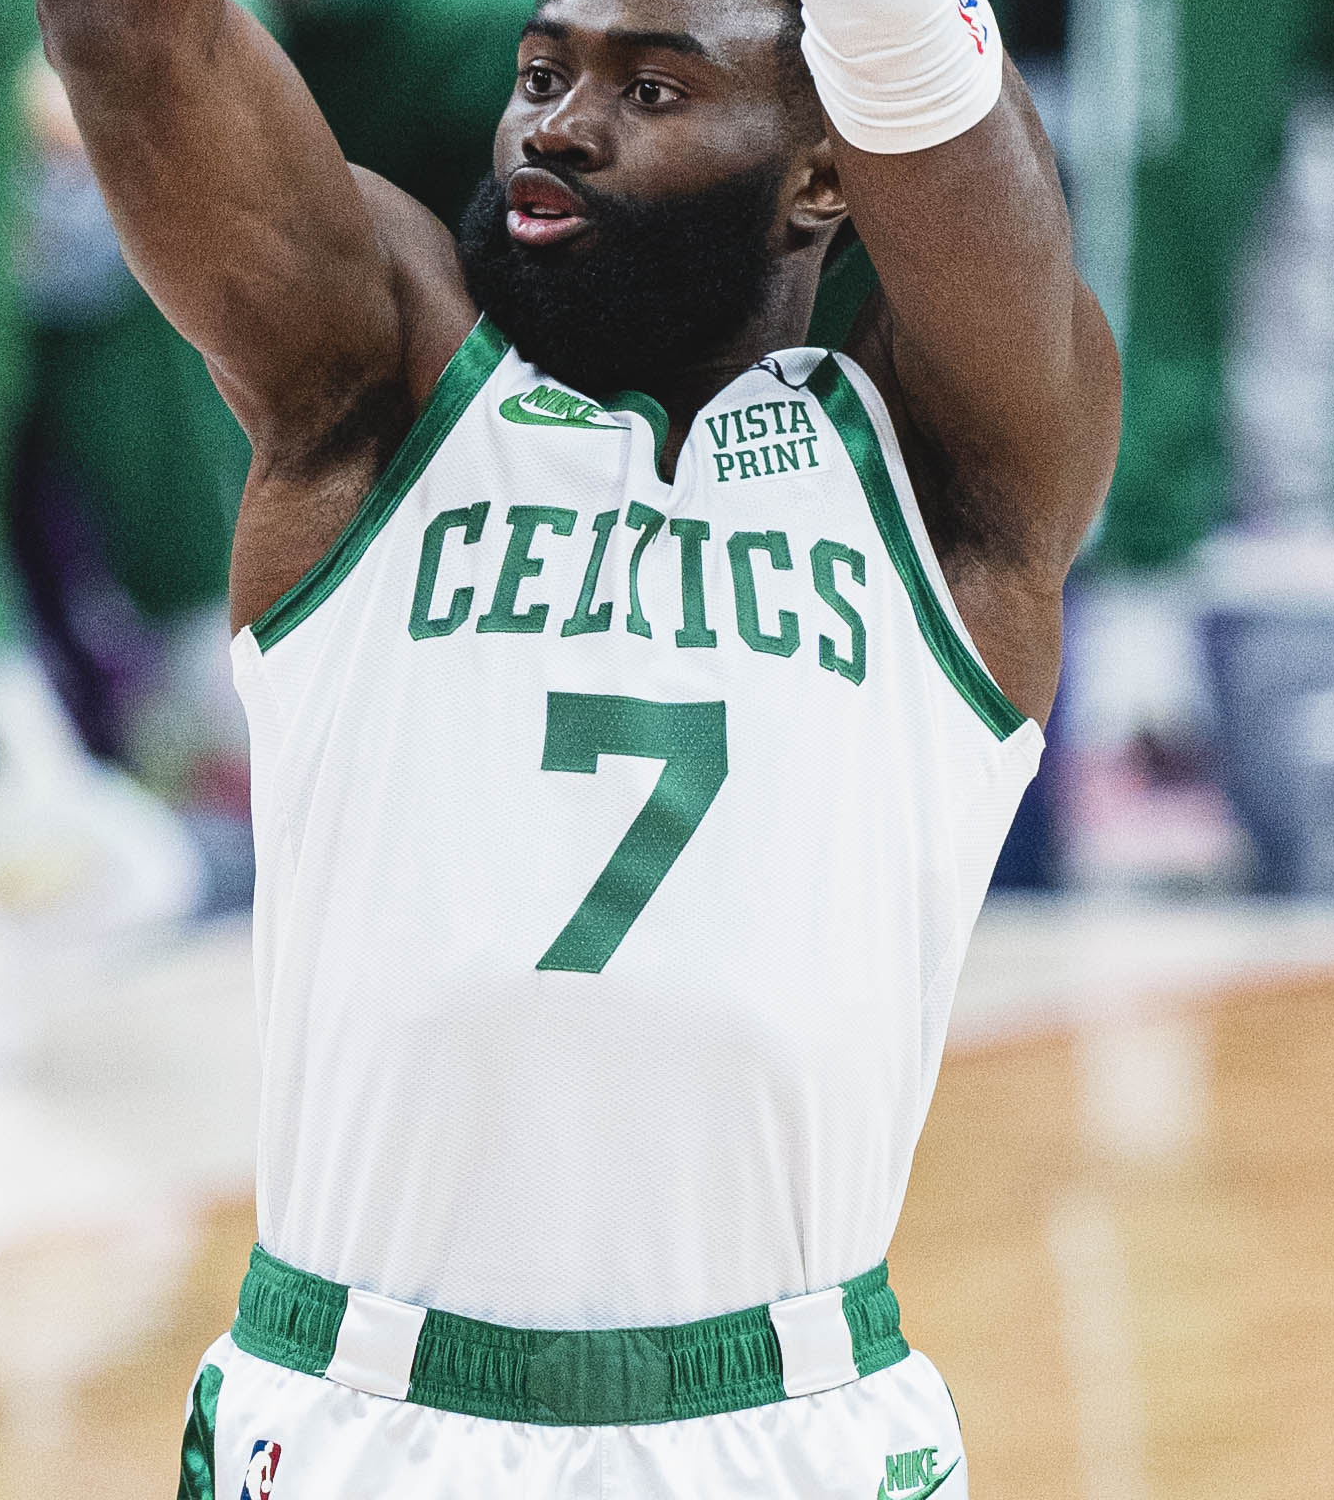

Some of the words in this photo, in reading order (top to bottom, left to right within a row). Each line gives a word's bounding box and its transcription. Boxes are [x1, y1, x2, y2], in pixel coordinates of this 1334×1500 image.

[522, 384, 605, 420] NIKE
[705, 401, 816, 449] VISTA
[713, 435, 819, 482] PRINT
[409, 500, 866, 686] CELTICS
[536, 691, 728, 973] 7
[885, 1446, 938, 1491] NIKE
